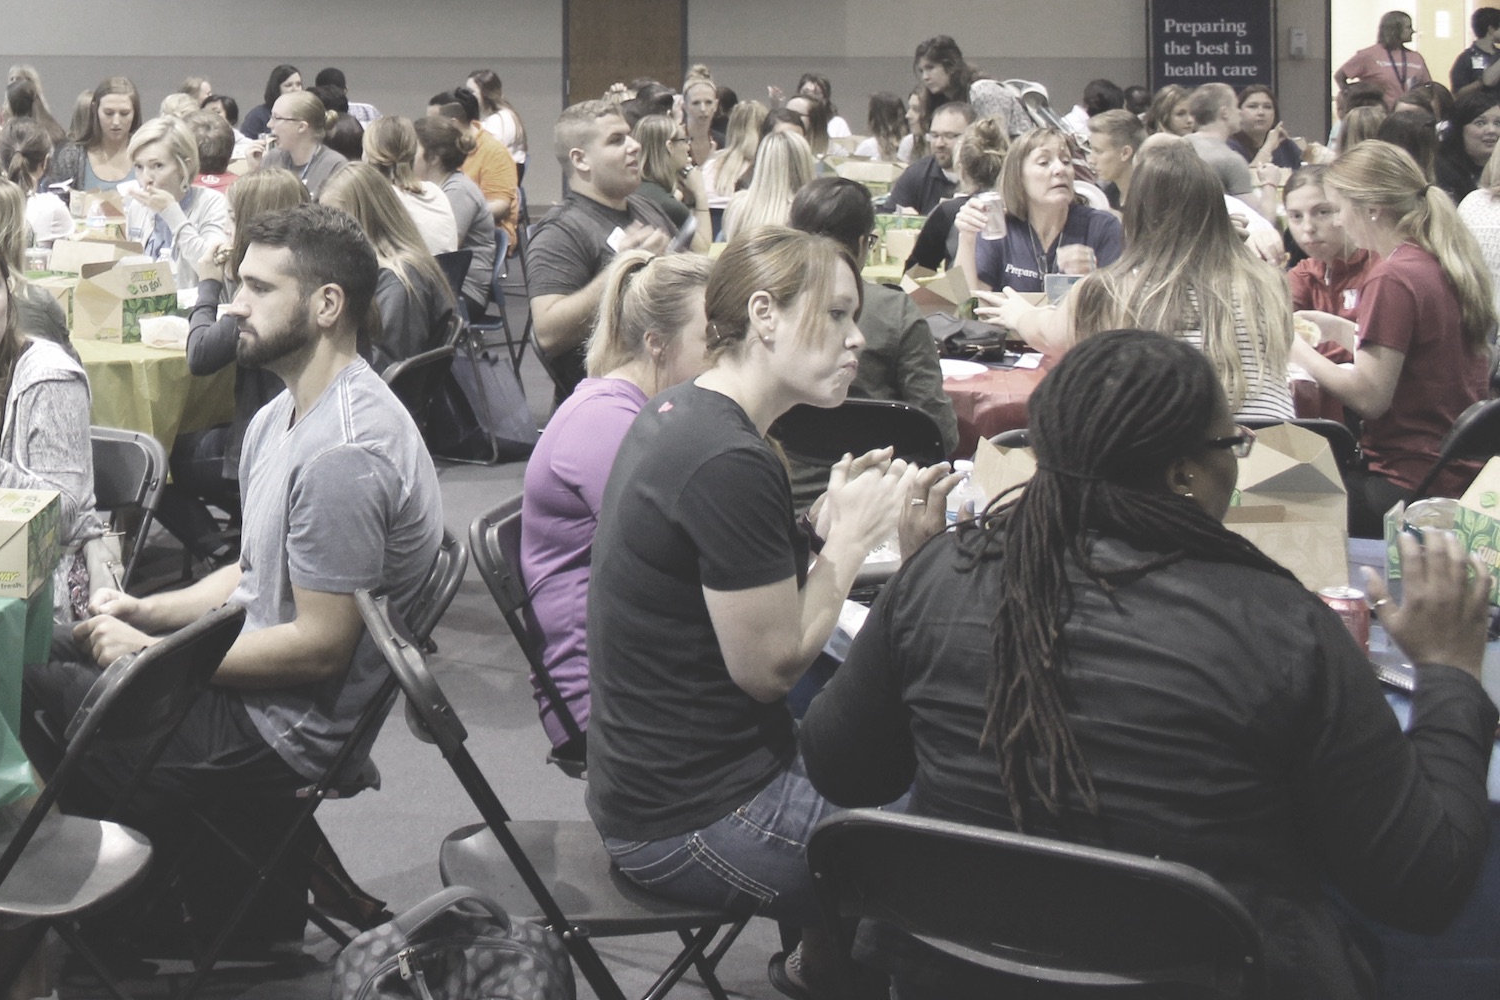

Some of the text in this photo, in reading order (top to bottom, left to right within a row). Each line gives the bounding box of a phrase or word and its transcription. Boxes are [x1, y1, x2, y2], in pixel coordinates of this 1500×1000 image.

[1164, 19, 1247, 37] Preparing
[1164, 40, 1253, 55] the best in
[1164, 62, 1258, 77] health care
[1004, 263, 1039, 279] Prepare
[139, 278, 162, 293] to go!
